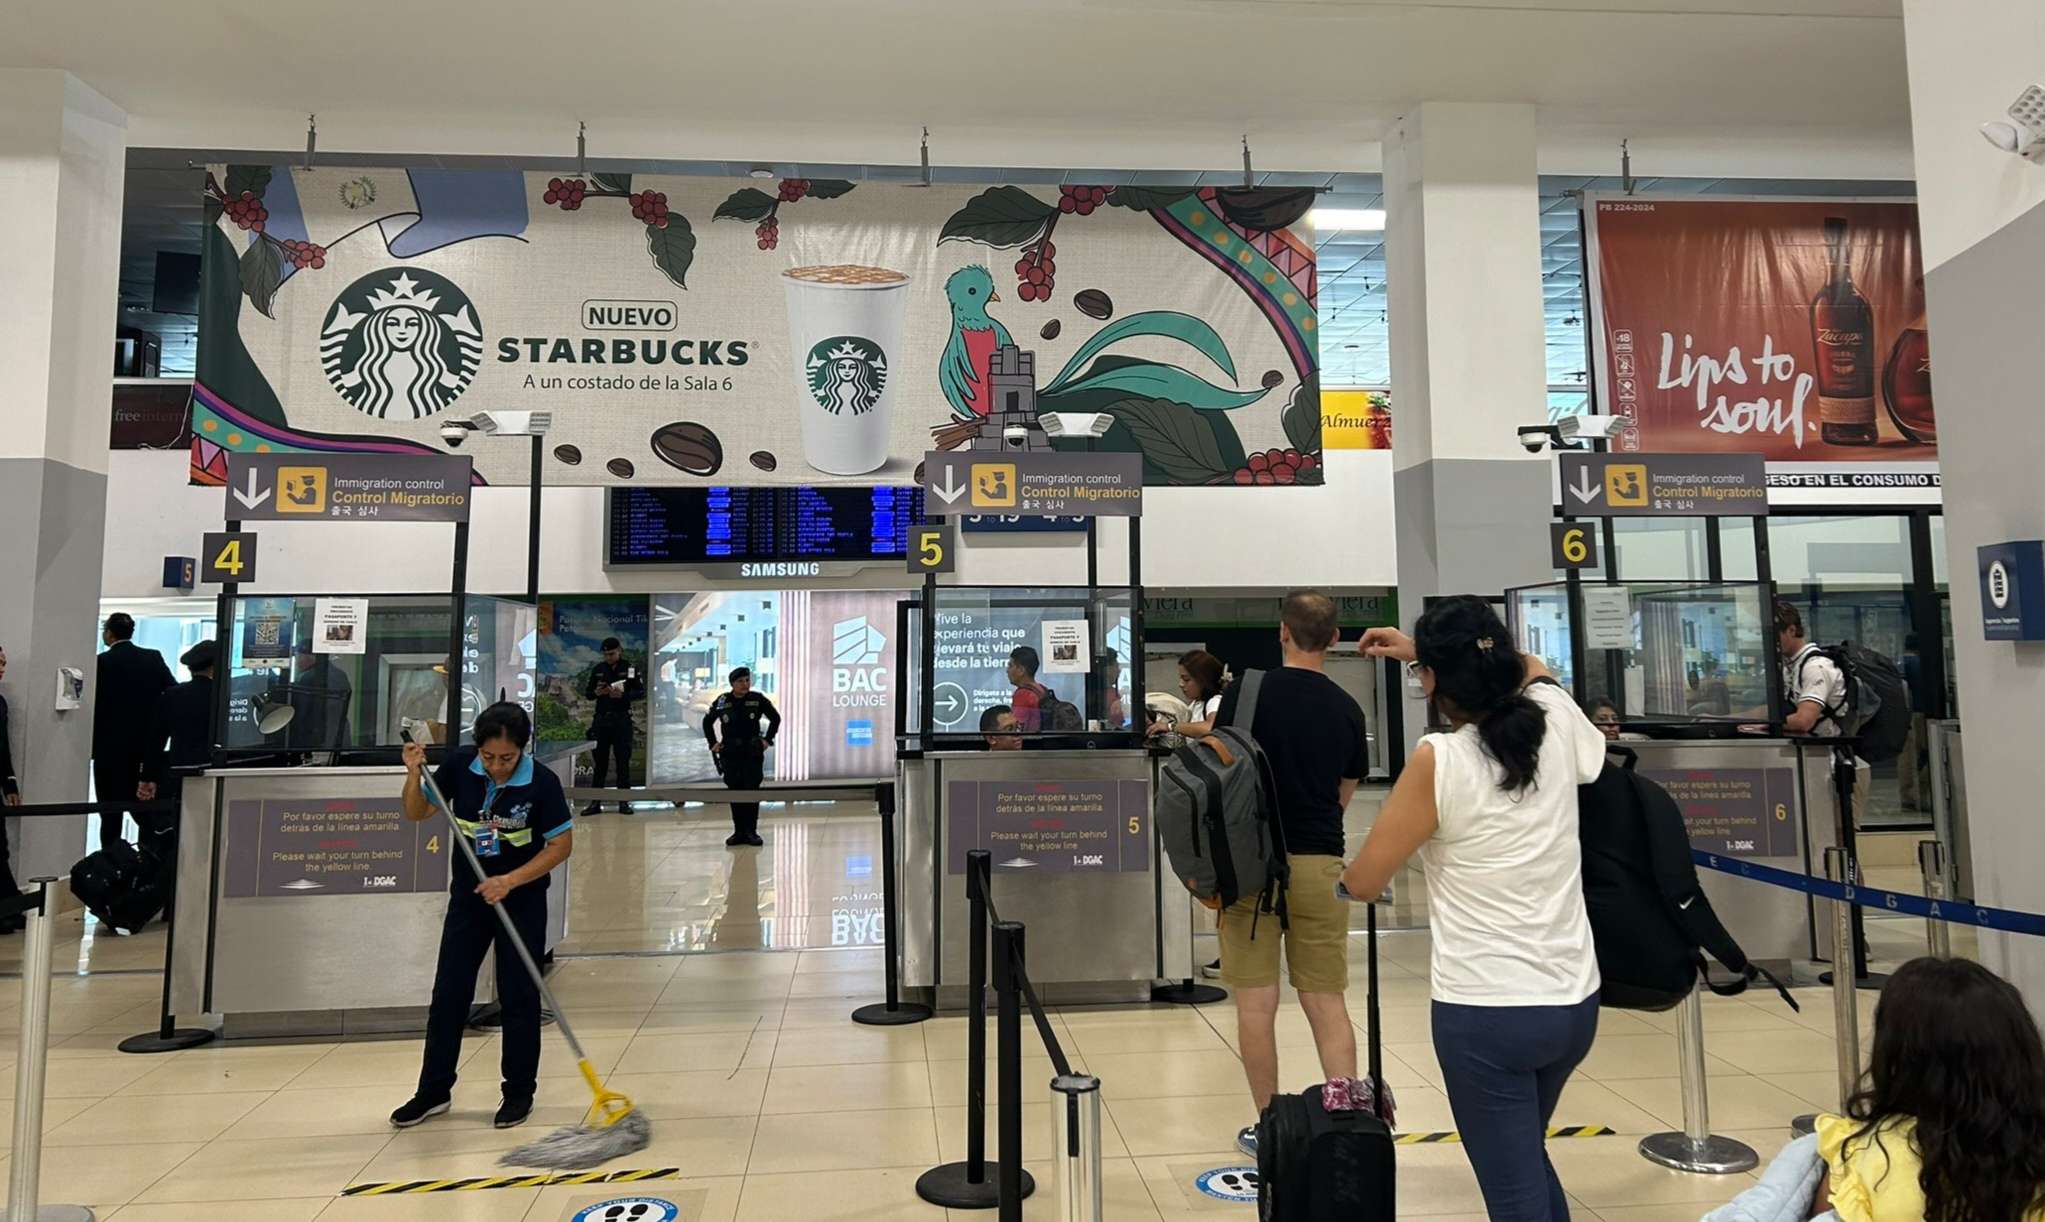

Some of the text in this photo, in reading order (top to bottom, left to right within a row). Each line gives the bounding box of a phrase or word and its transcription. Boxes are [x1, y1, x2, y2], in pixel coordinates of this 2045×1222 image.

[589, 307, 672, 326] NUEVO
[497, 337, 749, 366] STARBUCKS
[1657, 332, 1794, 411] Lips to
[523, 374, 733, 391] A un costado de la Sala 6
[334, 477, 444, 491] Immigration control
[1022, 474, 1122, 486] Immigration control
[1652, 474, 1745, 485] Immigration control
[1806, 475, 1825, 486] EN
[1830, 475, 1849, 486] EL
[1852, 474, 1928, 486] CONSUMO
[332, 491, 464, 508] Control Migratorio
[1022, 486, 1140, 501] Control Migratorio
[1652, 486, 1764, 500] Control Migratorio
[920, 532, 943, 567] 5
[1562, 528, 1588, 562] 6
[214, 540, 244, 576] 4
[184, 563, 192, 582] 5
[741, 562, 820, 577] SAMSUNG
[962, 612, 972, 624] la
[934, 627, 1026, 640] xperiencia que
[976, 642, 990, 654] tu
[970, 656, 980, 668] la
[833, 668, 887, 692] BAC
[833, 694, 887, 708] LOUNGE
[998, 792, 1102, 802] Por favor espere su turno
[996, 804, 1022, 813] detrás
[1024, 804, 1035, 812] de
[1037, 804, 1045, 812] la
[1776, 804, 1786, 820] 6
[283, 810, 400, 822] Por favor espere su turno
[281, 823, 310, 832] detrás
[312, 823, 324, 832] de
[326, 823, 335, 832] la
[1128, 816, 1140, 834] 5
[992, 830, 1108, 840] Please wait your turn behind
[426, 835, 440, 854] 4
[1020, 842, 1034, 850] the
[1036, 842, 1061, 851] yellow
[272, 850, 403, 862] Please wait your turn behind
[1083, 855, 1102, 865] DGAC
[306, 863, 320, 872] the
[322, 862, 350, 873] yellow
[374, 876, 396, 887] DGAC
